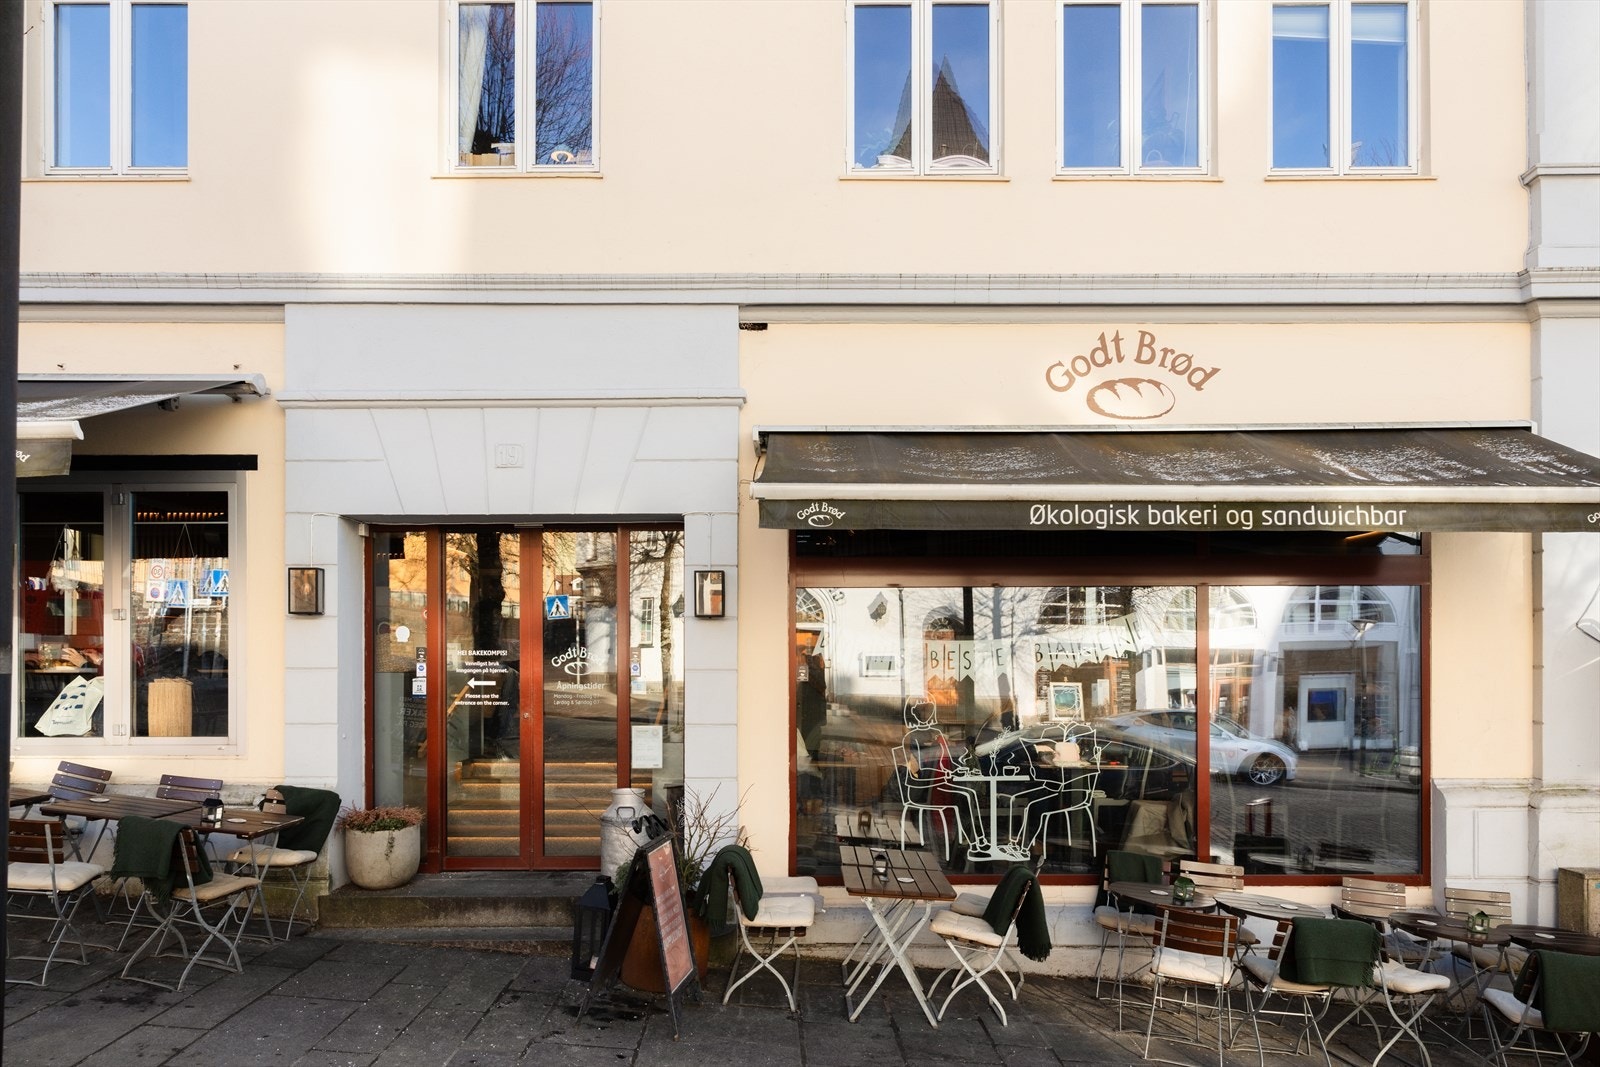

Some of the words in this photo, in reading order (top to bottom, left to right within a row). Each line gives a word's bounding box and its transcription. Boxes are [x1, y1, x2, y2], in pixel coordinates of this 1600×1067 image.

[1045, 329, 1125, 392] Godt
[1133, 330, 1222, 392] Brød
[796, 502, 820, 520] Godt
[821, 502, 846, 520] Brød
[1029, 504, 1140, 529] Økologisk
[1147, 504, 1218, 525] bakeri
[1226, 509, 1254, 530] og
[1261, 505, 1407, 526] sandwichbar
[1587, 512, 1600, 524] Go
[551, 646, 578, 667] Godt
[556, 680, 606, 691] Åpningstider
